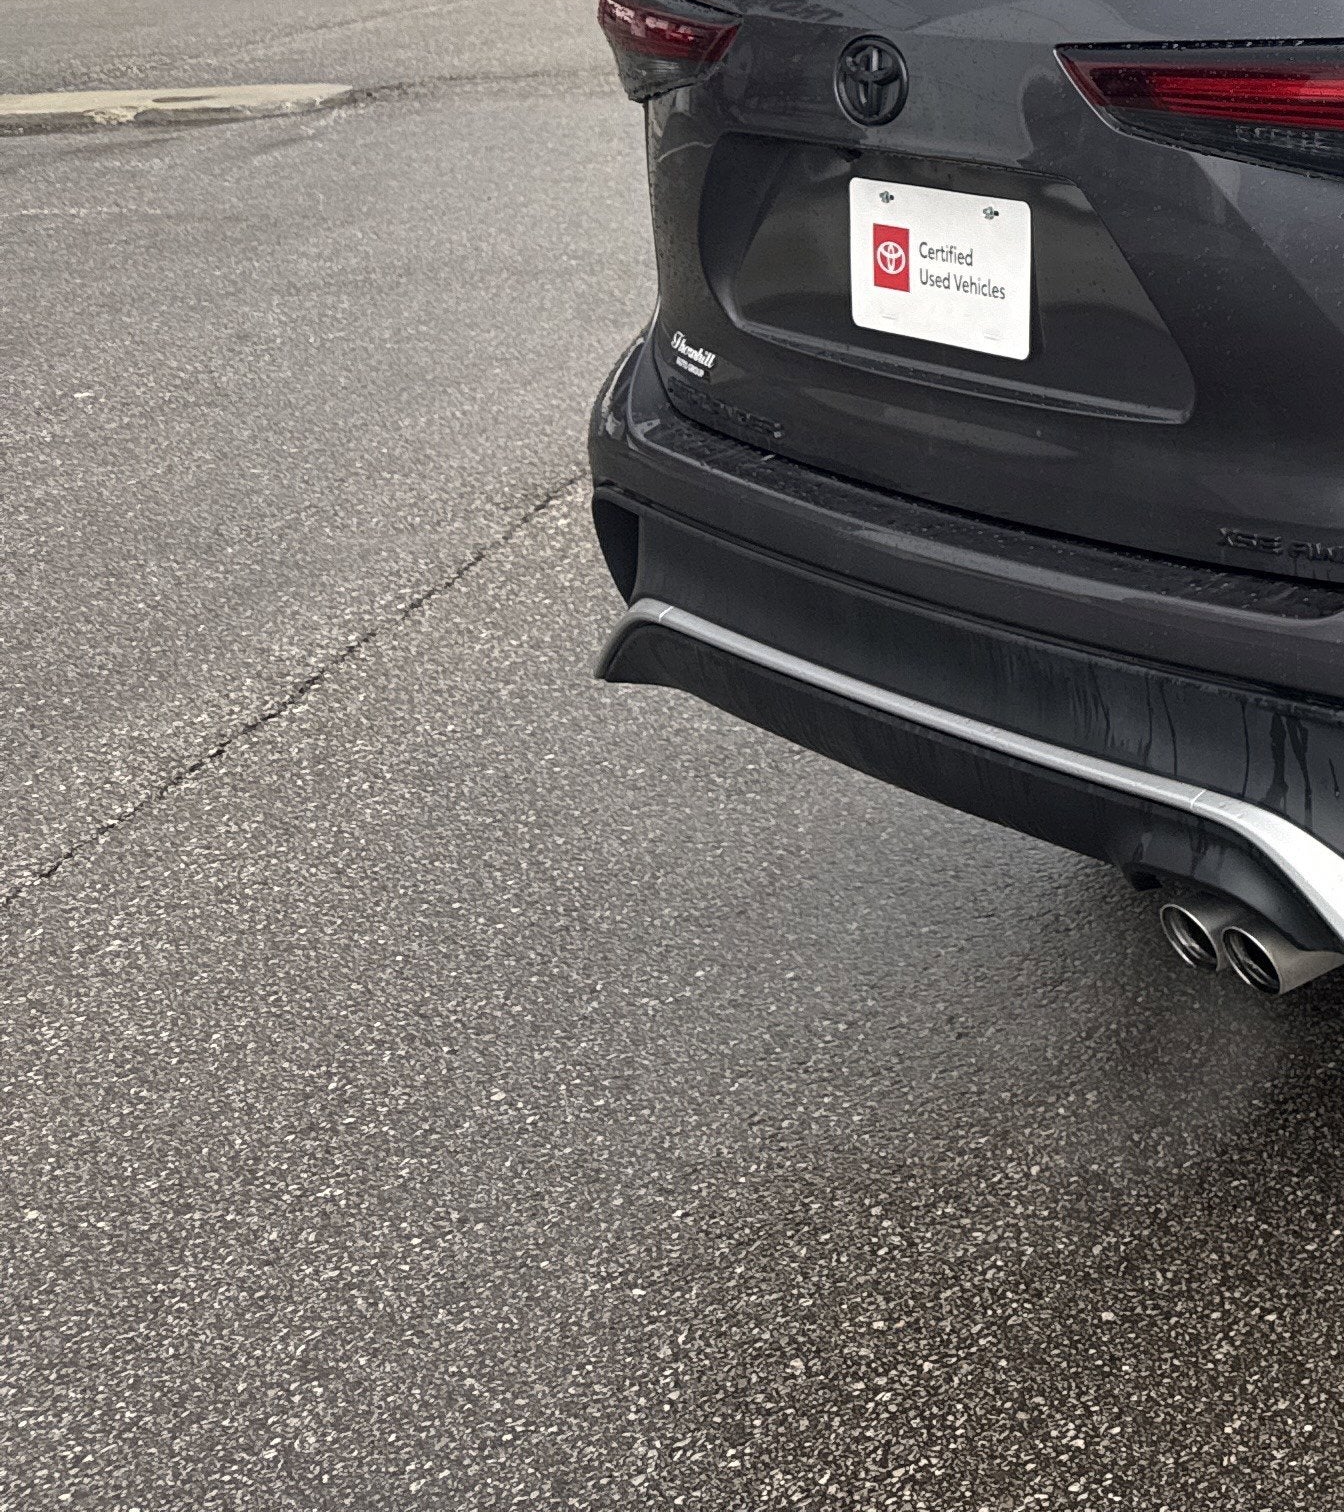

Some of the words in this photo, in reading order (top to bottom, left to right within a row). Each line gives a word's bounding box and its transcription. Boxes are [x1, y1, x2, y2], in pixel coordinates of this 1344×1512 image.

[919, 241, 973, 267] Certified
[919, 268, 951, 289] Used
[953, 273, 1006, 300] Vehicles
[1217, 527, 1282, 555] XSE
